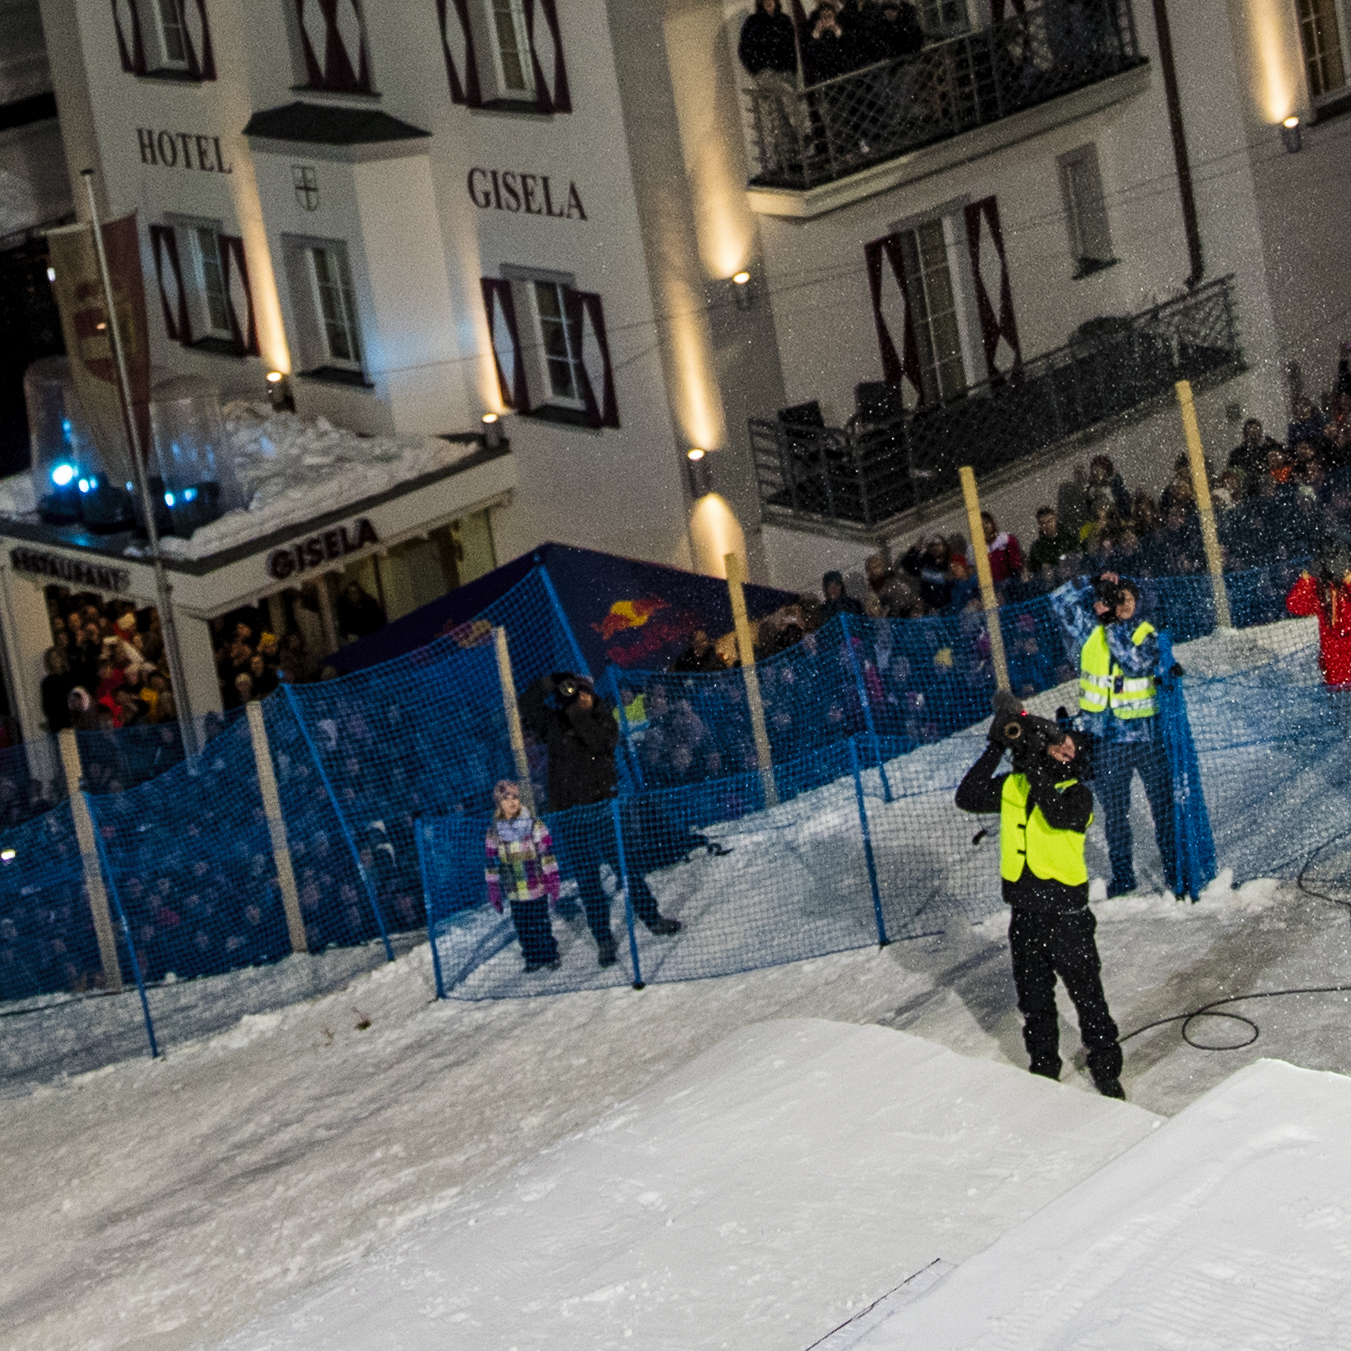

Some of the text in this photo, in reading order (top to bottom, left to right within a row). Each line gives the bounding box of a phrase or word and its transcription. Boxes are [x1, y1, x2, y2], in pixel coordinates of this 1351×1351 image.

[137, 127, 588, 222] HOTEL GISELA
[266, 516, 380, 580] GISELA
